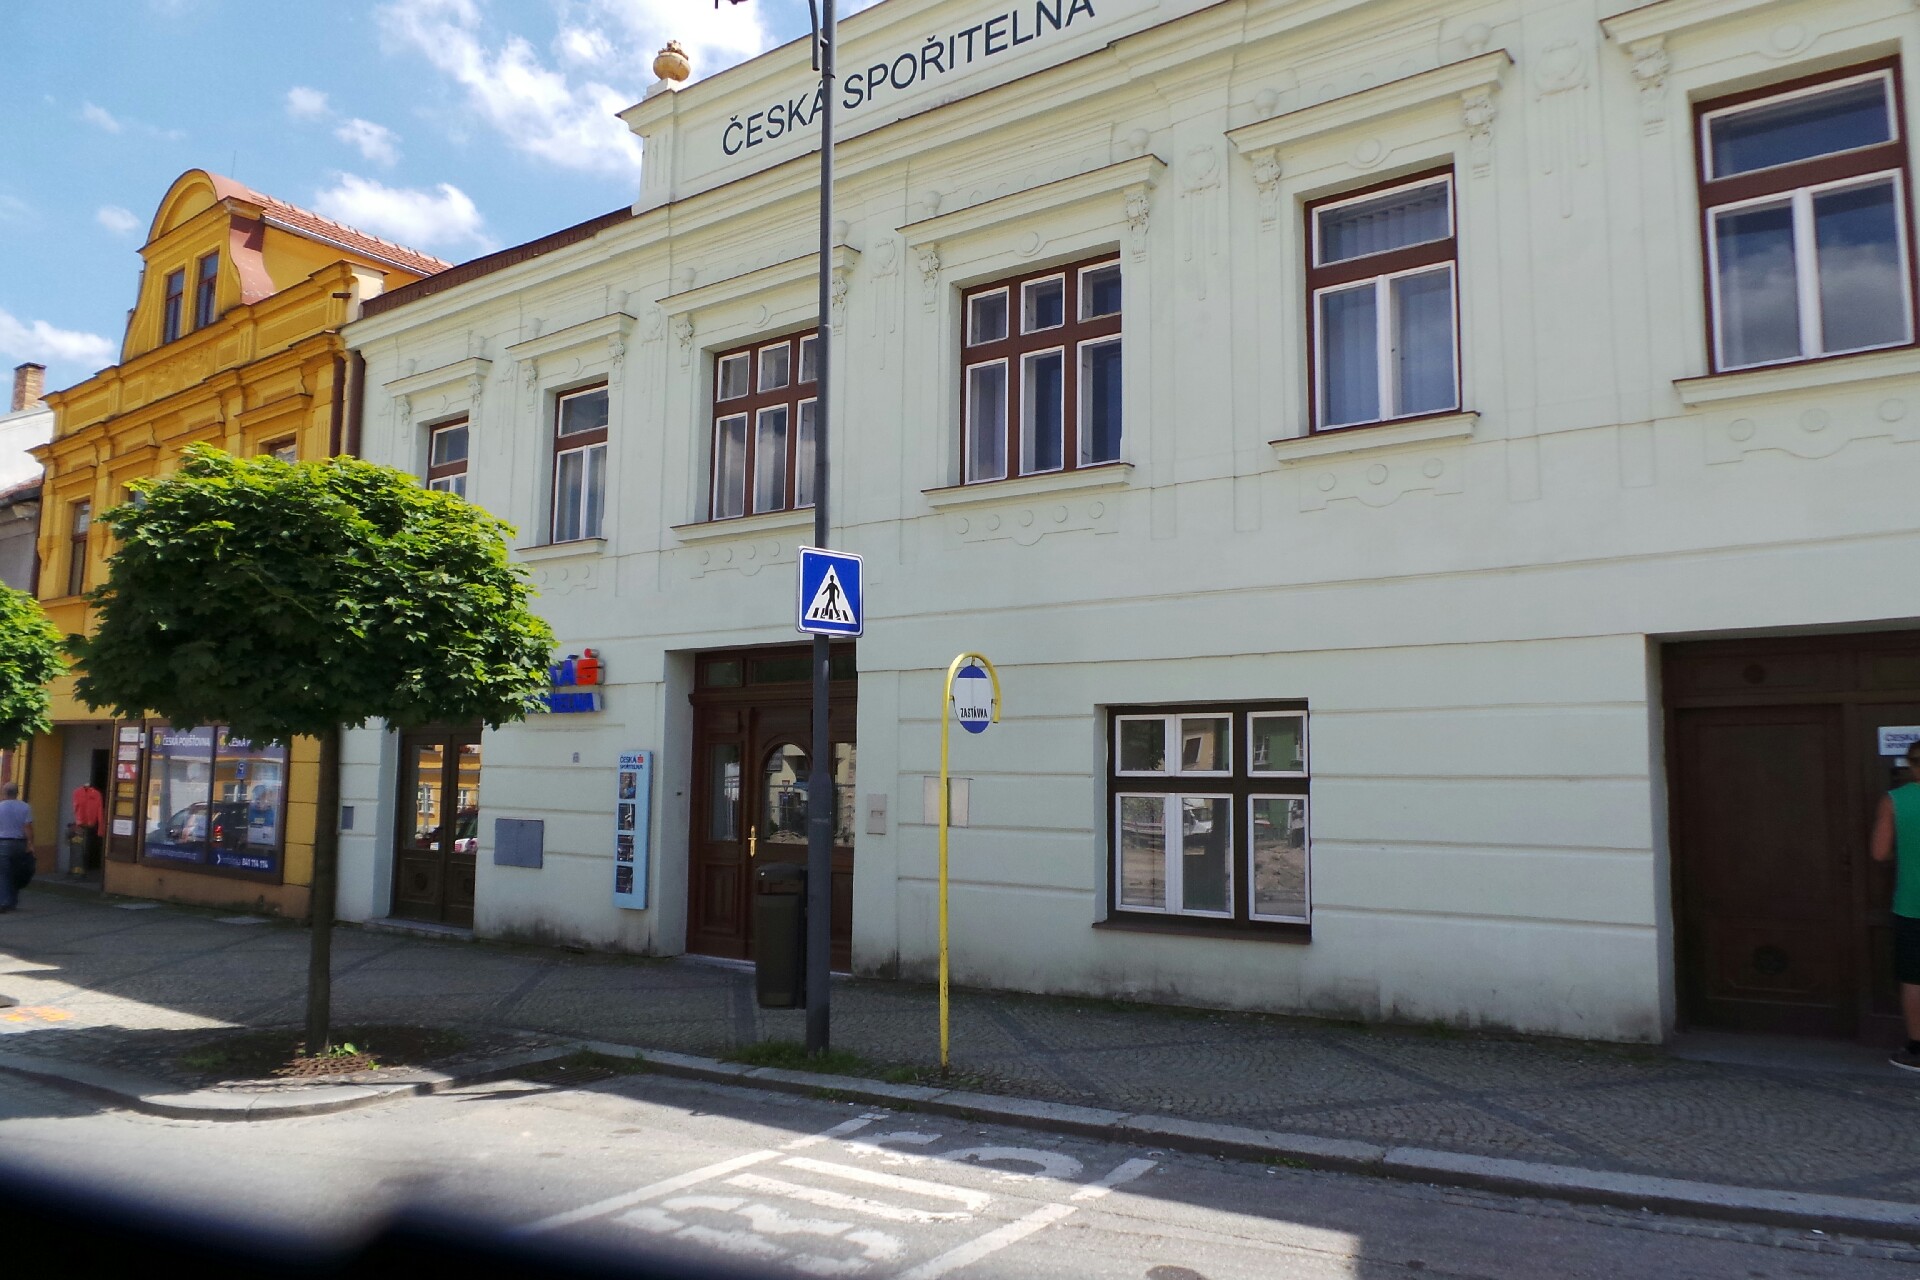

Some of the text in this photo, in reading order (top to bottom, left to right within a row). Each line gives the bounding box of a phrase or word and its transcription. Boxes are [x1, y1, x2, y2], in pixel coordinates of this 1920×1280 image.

[842, 0, 1095, 109] SPOŘITELNA
[960, 706, 988, 718] ZASTÁVKA
[612, 1129, 1085, 1277] BUS
